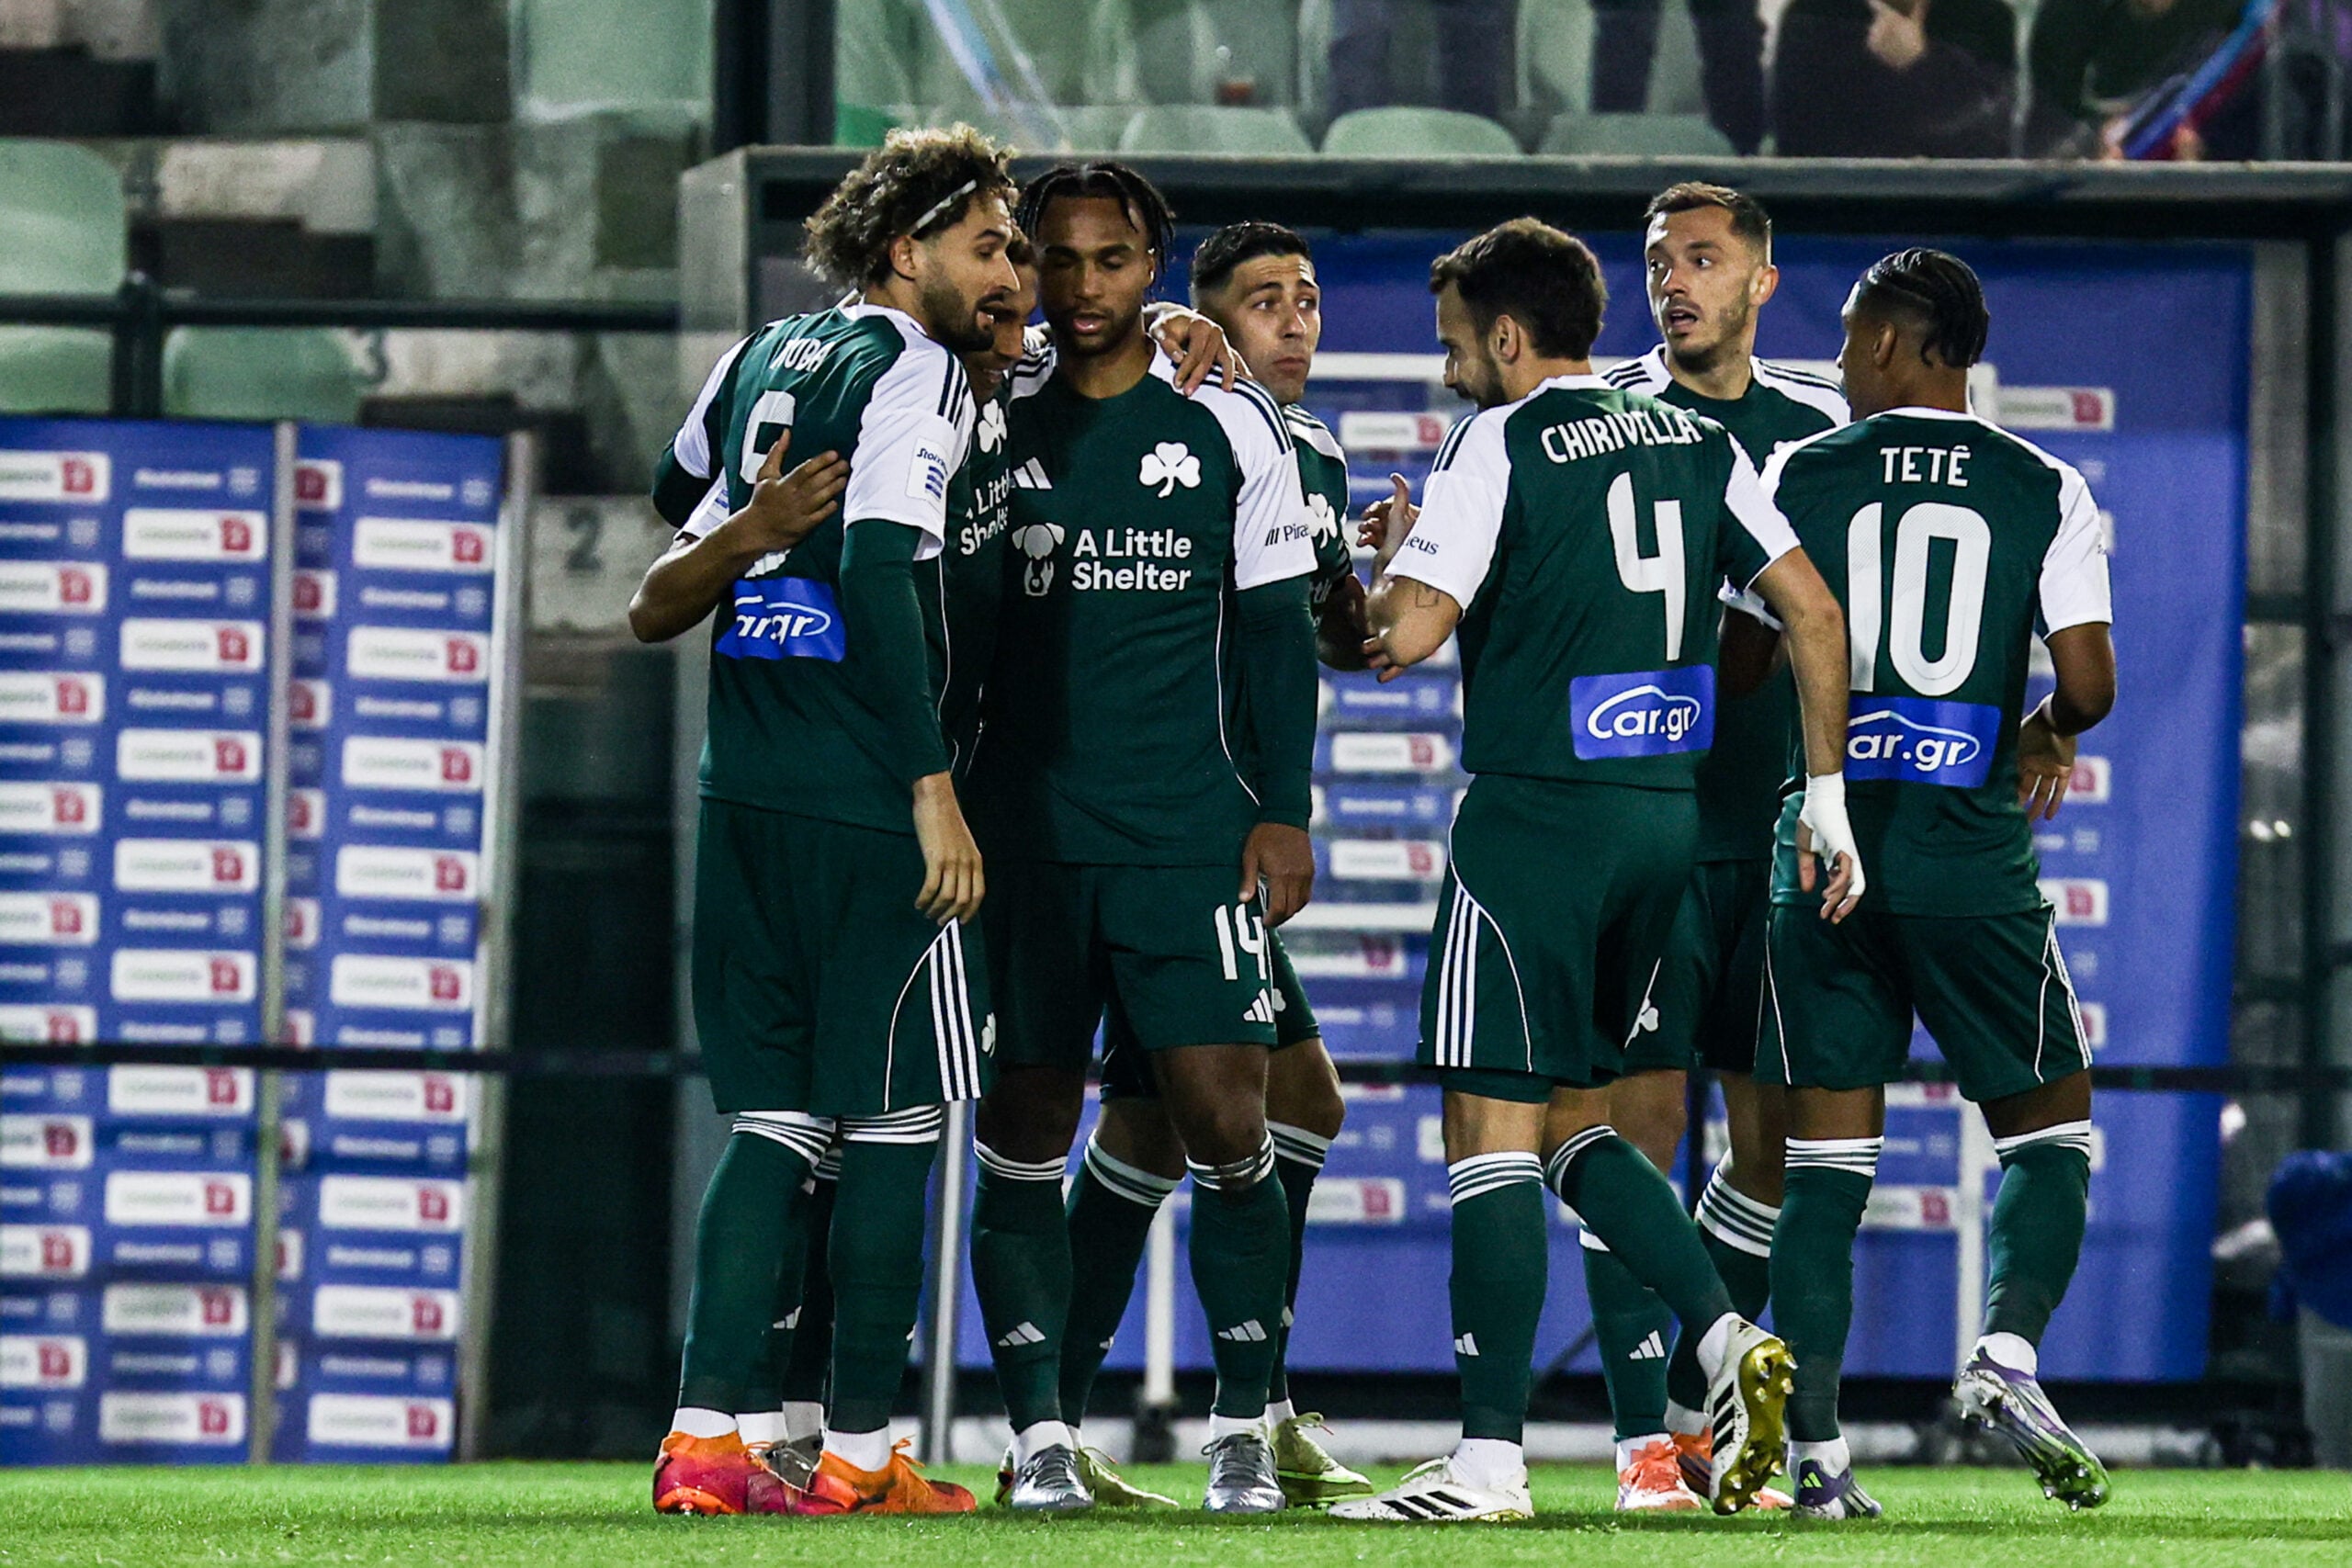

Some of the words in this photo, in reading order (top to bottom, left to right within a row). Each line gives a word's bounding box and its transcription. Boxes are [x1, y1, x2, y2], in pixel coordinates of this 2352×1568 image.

[1541, 411, 1702, 464] CHIRIVELLA
[976, 468, 1010, 514] Littl
[1880, 446, 1971, 487] TETÊ
[1073, 529, 1099, 558] A
[1105, 527, 1192, 558] Little
[1607, 471, 1685, 661] 4
[1071, 560, 1192, 591] Shelter
[1848, 502, 1991, 696] 10
[1588, 684, 1700, 741] Car.gr
[1848, 720, 1973, 772] ar.gr
[1215, 903, 1267, 980] 14
